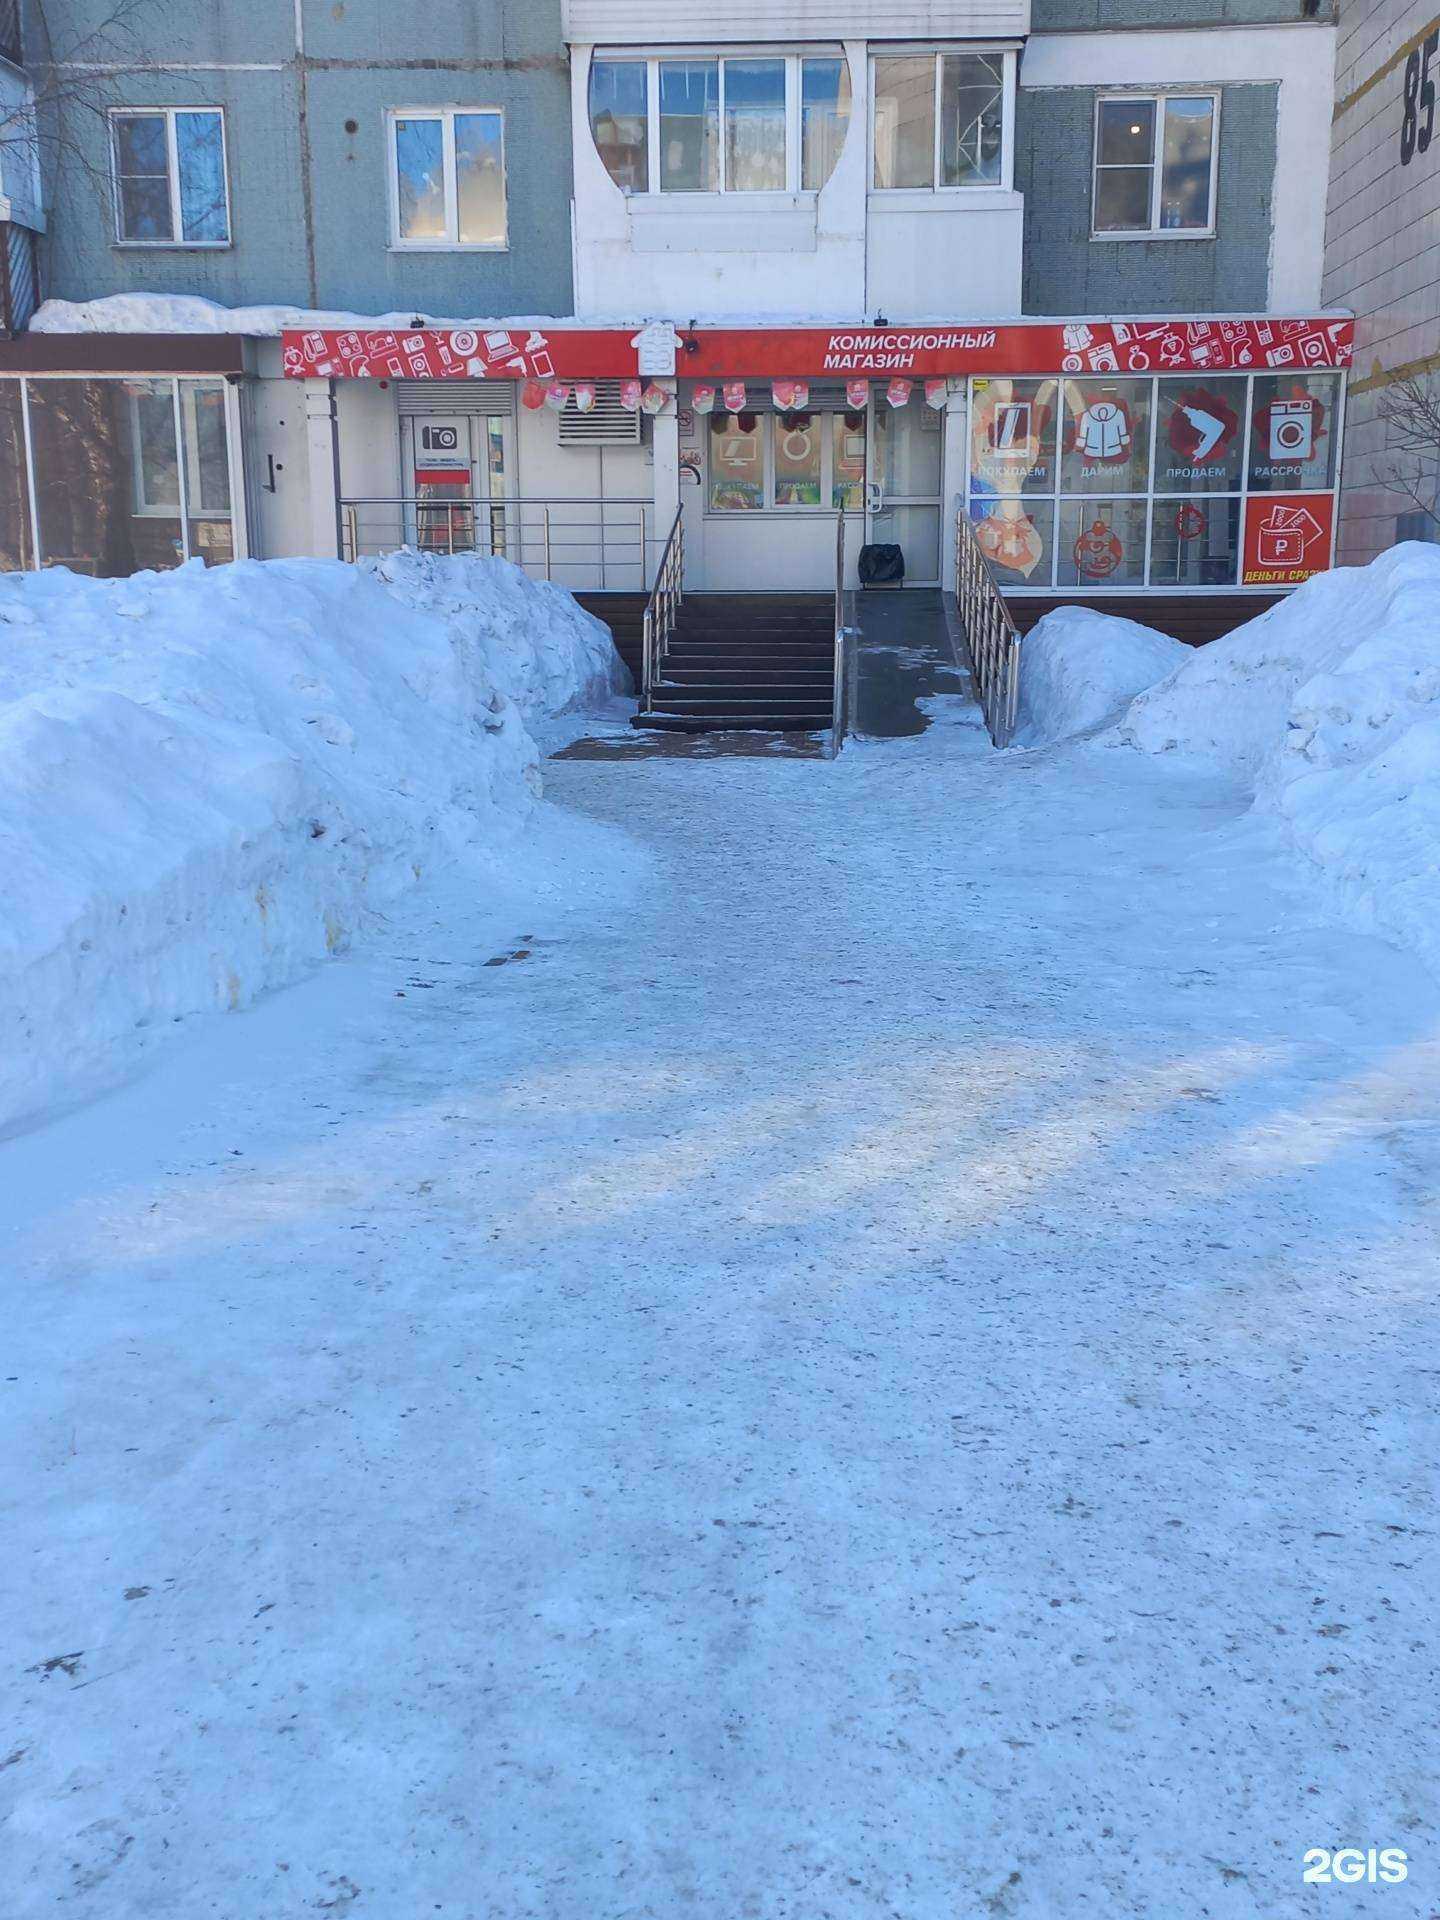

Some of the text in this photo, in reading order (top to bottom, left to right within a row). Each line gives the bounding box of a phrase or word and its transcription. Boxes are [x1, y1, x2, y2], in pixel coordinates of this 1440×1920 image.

[1400, 28, 1439, 167] 85
[828, 330, 997, 351] КОМИССИОННЫЙ
[823, 353, 915, 369] МАГАЗИН
[1080, 464, 1124, 479] ДАРИМ
[1166, 467, 1227, 480] ПРОДАЕМ
[1244, 569, 1319, 583] ДЕНЬГИ СРА
